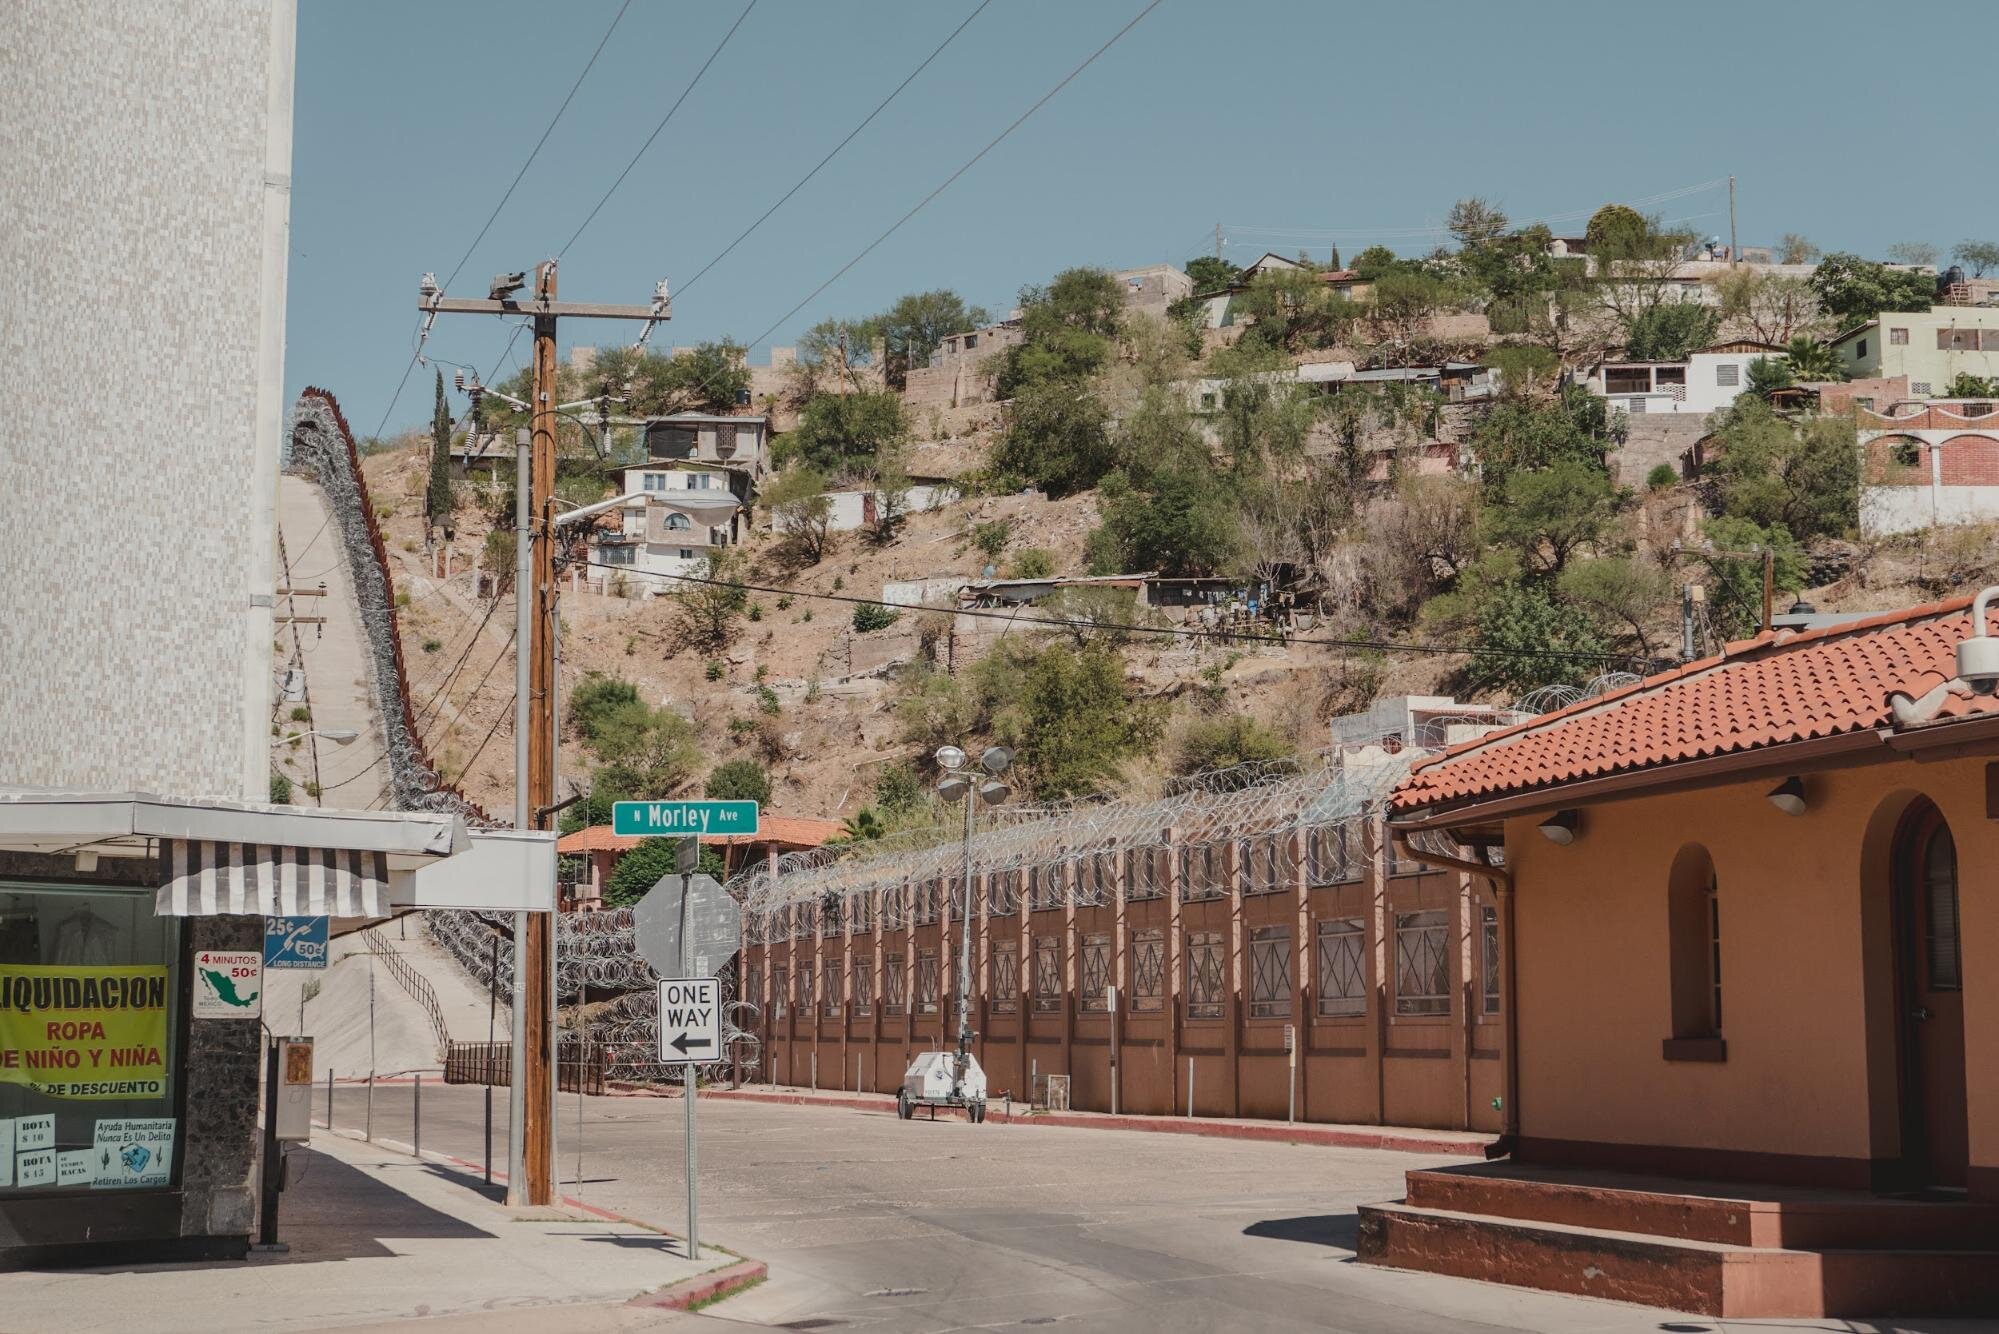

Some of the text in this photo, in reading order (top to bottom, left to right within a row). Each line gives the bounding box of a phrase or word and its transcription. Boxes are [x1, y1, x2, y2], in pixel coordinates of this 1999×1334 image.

[634, 805, 738, 833] N Morley Ave
[201, 954, 257, 965] 4 MINUTOS
[293, 960, 327, 968] DISTANCE
[231, 968, 257, 977] 50¢
[0, 977, 165, 1012] IQUIDACION
[668, 986, 711, 1005] ONE
[668, 1008, 712, 1027] WAY
[47, 1022, 106, 1040] ROPA
[26, 1046, 80, 1068] NIÑO
[89, 1049, 103, 1067] Y
[110, 1044, 162, 1067] NIÑA
[47, 1084, 65, 1096] DE
[71, 1081, 159, 1096] DESCUENTO
[23, 1121, 51, 1131] BOTA
[97, 1121, 172, 1133] Ayuda Humanitaria
[97, 1132, 171, 1143] Nunca Es Un Delito
[24, 1156, 51, 1166] BOTA
[94, 1175, 167, 1186] Retiren Los Cargos
